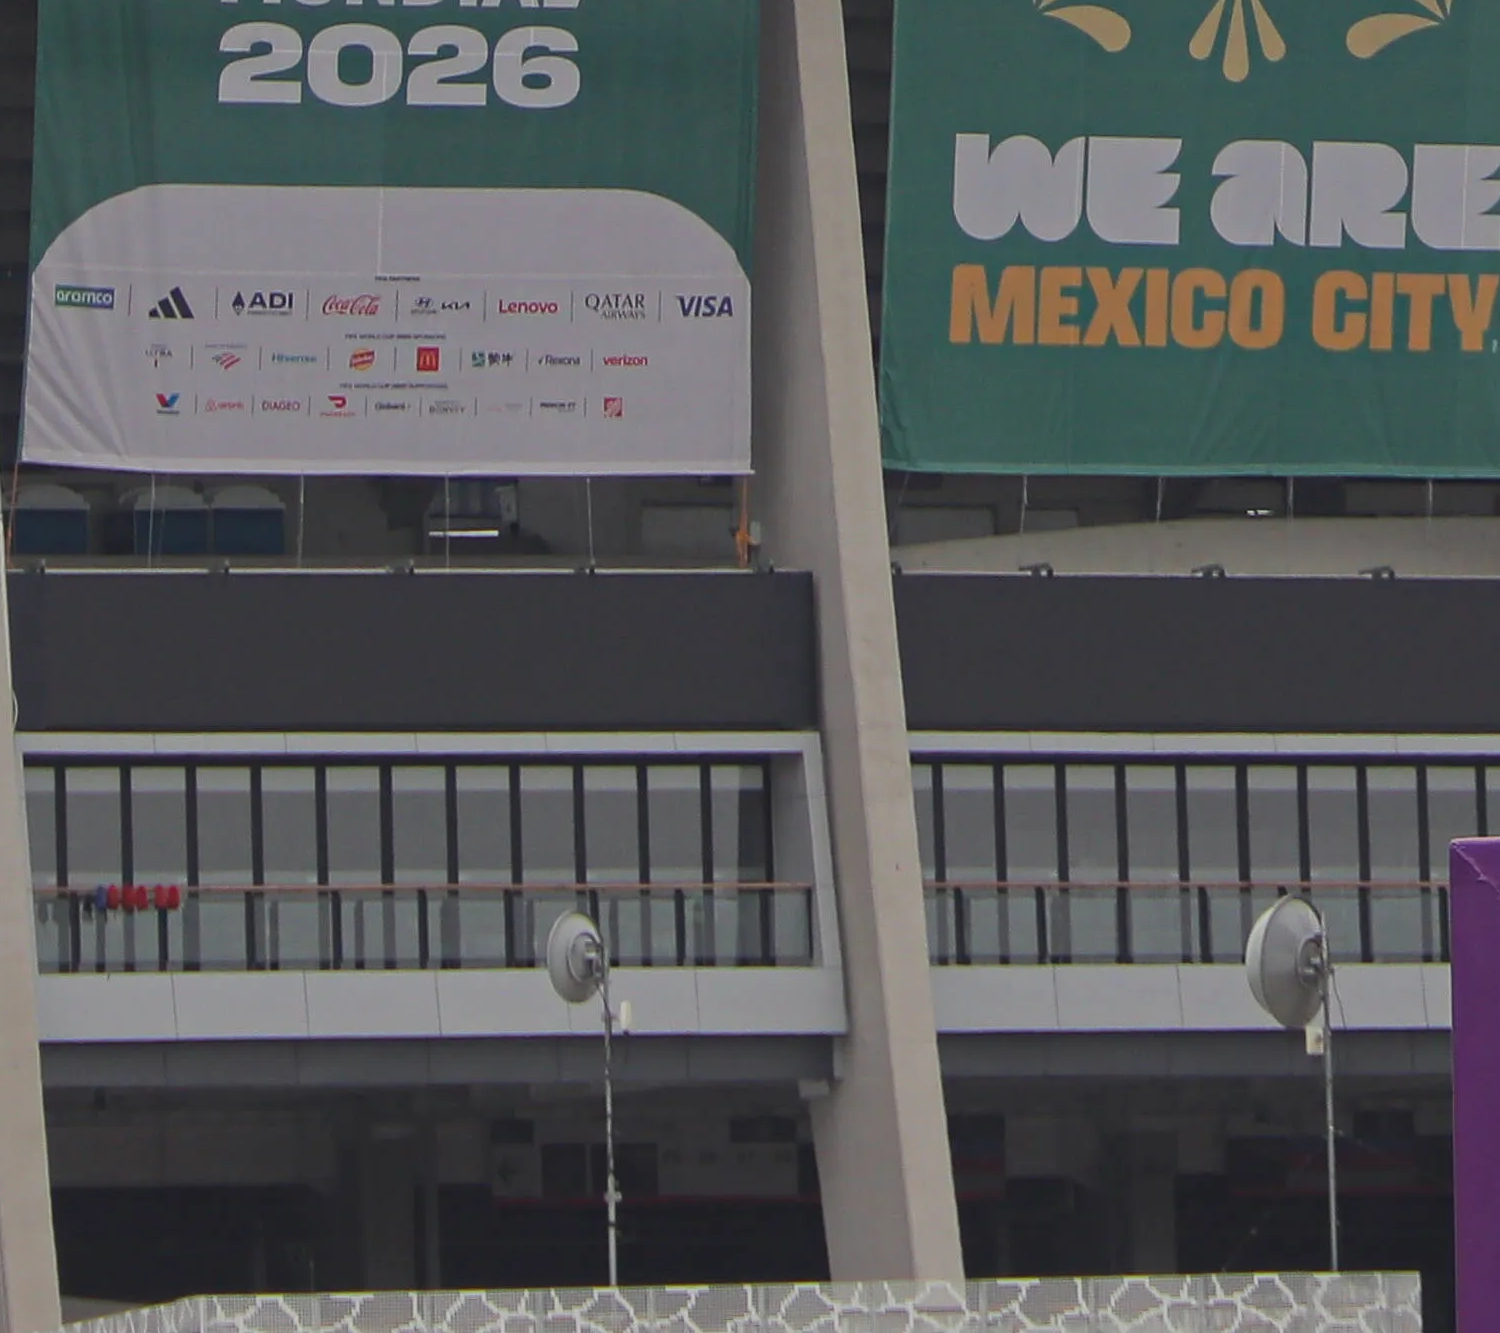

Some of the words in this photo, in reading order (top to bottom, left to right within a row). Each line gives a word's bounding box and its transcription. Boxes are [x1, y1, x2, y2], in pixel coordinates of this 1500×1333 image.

[217, 21, 581, 110] 2026
[952, 132, 1184, 247] WE
[55, 287, 114, 306] aramco
[248, 291, 294, 310] ADI
[584, 292, 646, 312] QATAR
[498, 298, 559, 315] Lenovo
[676, 295, 734, 318] VISA
[949, 264, 1286, 350] MEXICO
[1311, 270, 1500, 352] CITY
[603, 354, 649, 367] verizon
[261, 399, 301, 412] DIAGEO
